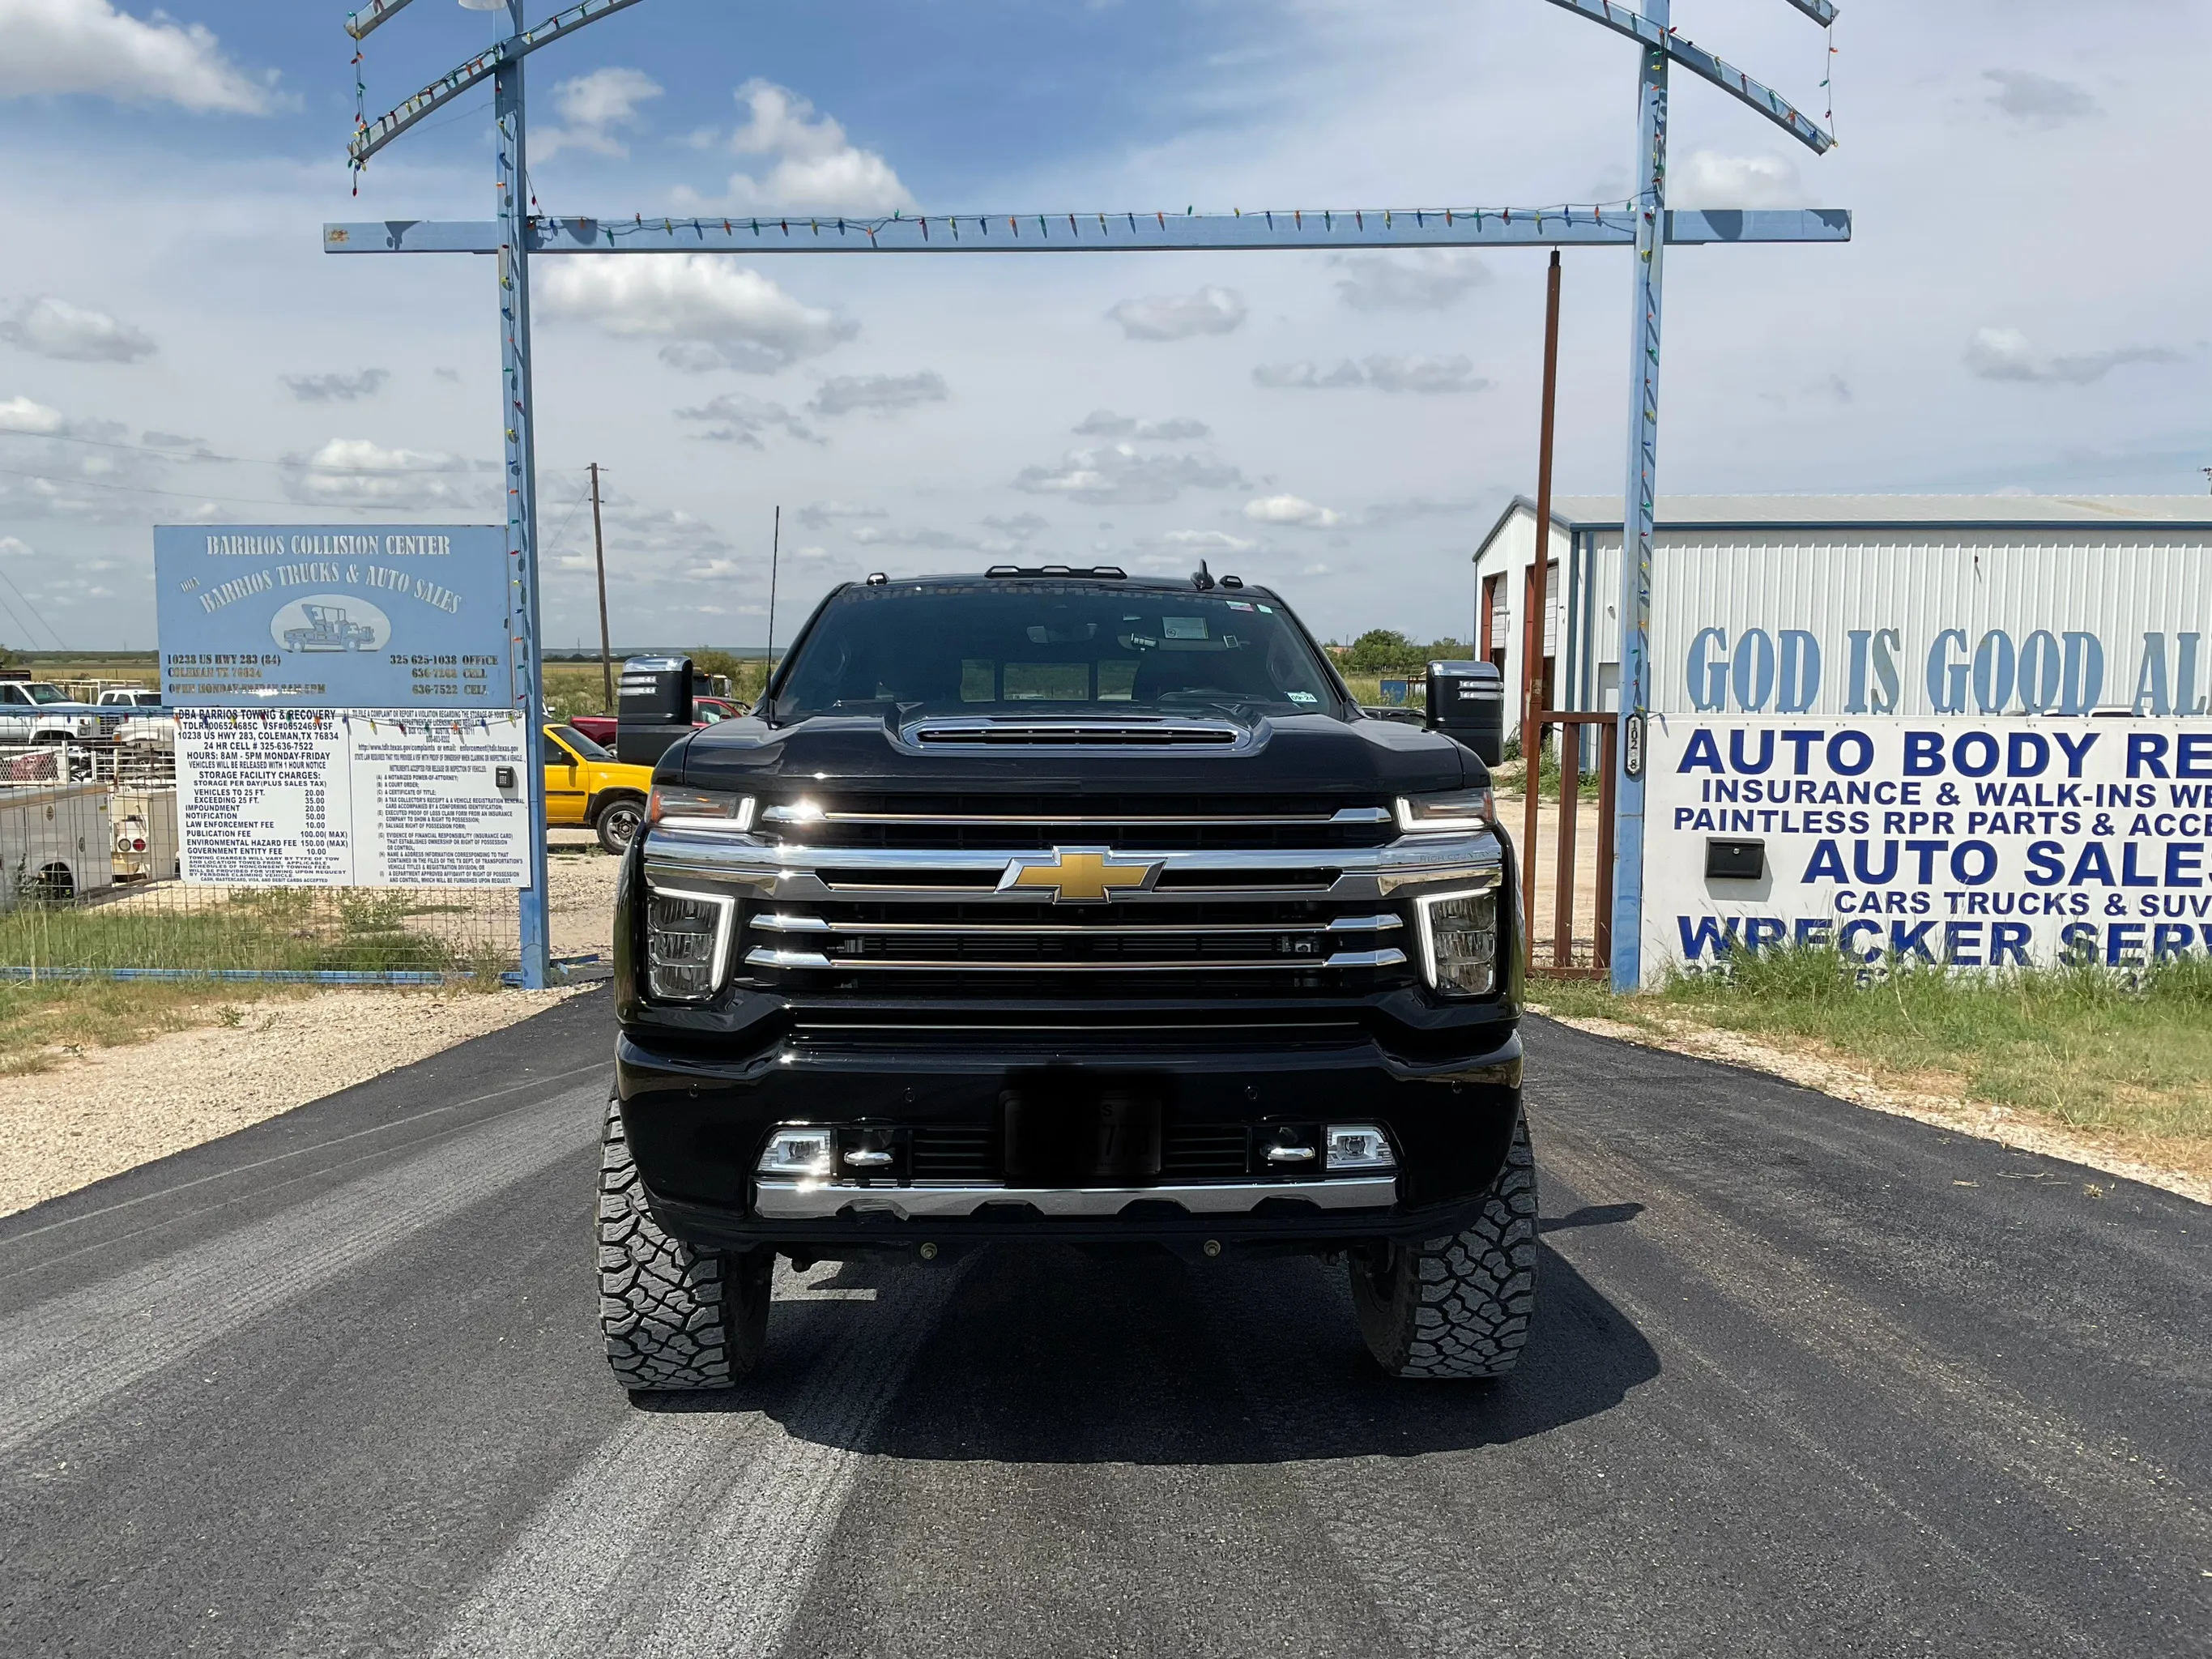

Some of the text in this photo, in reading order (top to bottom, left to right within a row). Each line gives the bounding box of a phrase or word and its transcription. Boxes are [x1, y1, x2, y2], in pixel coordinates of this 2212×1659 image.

[207, 535, 450, 555] BARRIOS COLLISION CENTER
[179, 577, 200, 592] DBA
[198, 562, 462, 614] BARRIOS TRUCKS & AUTO SALES
[168, 655, 280, 666] 10238 US HWY 283 (84)
[390, 655, 498, 665] 325 625-1038 OFFICE
[168, 667, 214, 677] COLEMAN
[216, 667, 229, 677] TX
[463, 669, 488, 678] CELL
[1686, 628, 2212, 716] GOD IS GOOD AL
[168, 684, 195, 693] OPEN
[412, 684, 458, 694] 636-7522
[178, 709, 196, 720] DBA
[200, 709, 237, 720] BARRIOS
[279, 710, 285, 720] &
[289, 709, 335, 720] RECOVERY
[178, 731, 201, 740] 10238
[204, 731, 215, 740] US
[218, 731, 237, 740] HWY
[239, 731, 256, 741] 283,
[260, 742, 313, 750] 325-636-7522
[245, 752, 262, 760] 5PM
[265, 752, 330, 760] MONDAY-FRIDAY
[1677, 729, 1875, 776] AUTO
[1901, 731, 2099, 778] BODY
[189, 761, 215, 769] VEHICLES
[199, 771, 320, 779] STORAGE FACILITY CHARGES:
[1703, 779, 1920, 805] INSURANCE
[1935, 783, 1959, 805] &
[1975, 783, 2155, 808] WALK-INS
[1674, 808, 1869, 834] PAINTLESS
[1882, 812, 1954, 834] RPR
[1967, 811, 2081, 834] PARTS
[2091, 813, 2114, 836] &
[327, 839, 348, 847] (MAX)
[1801, 839, 2212, 887] AUTO SALE
[1835, 891, 1930, 915] CARS
[1944, 892, 2089, 915] TRUCKS
[2103, 895, 2126, 916] &
[1677, 915, 2035, 967] WRECKER
